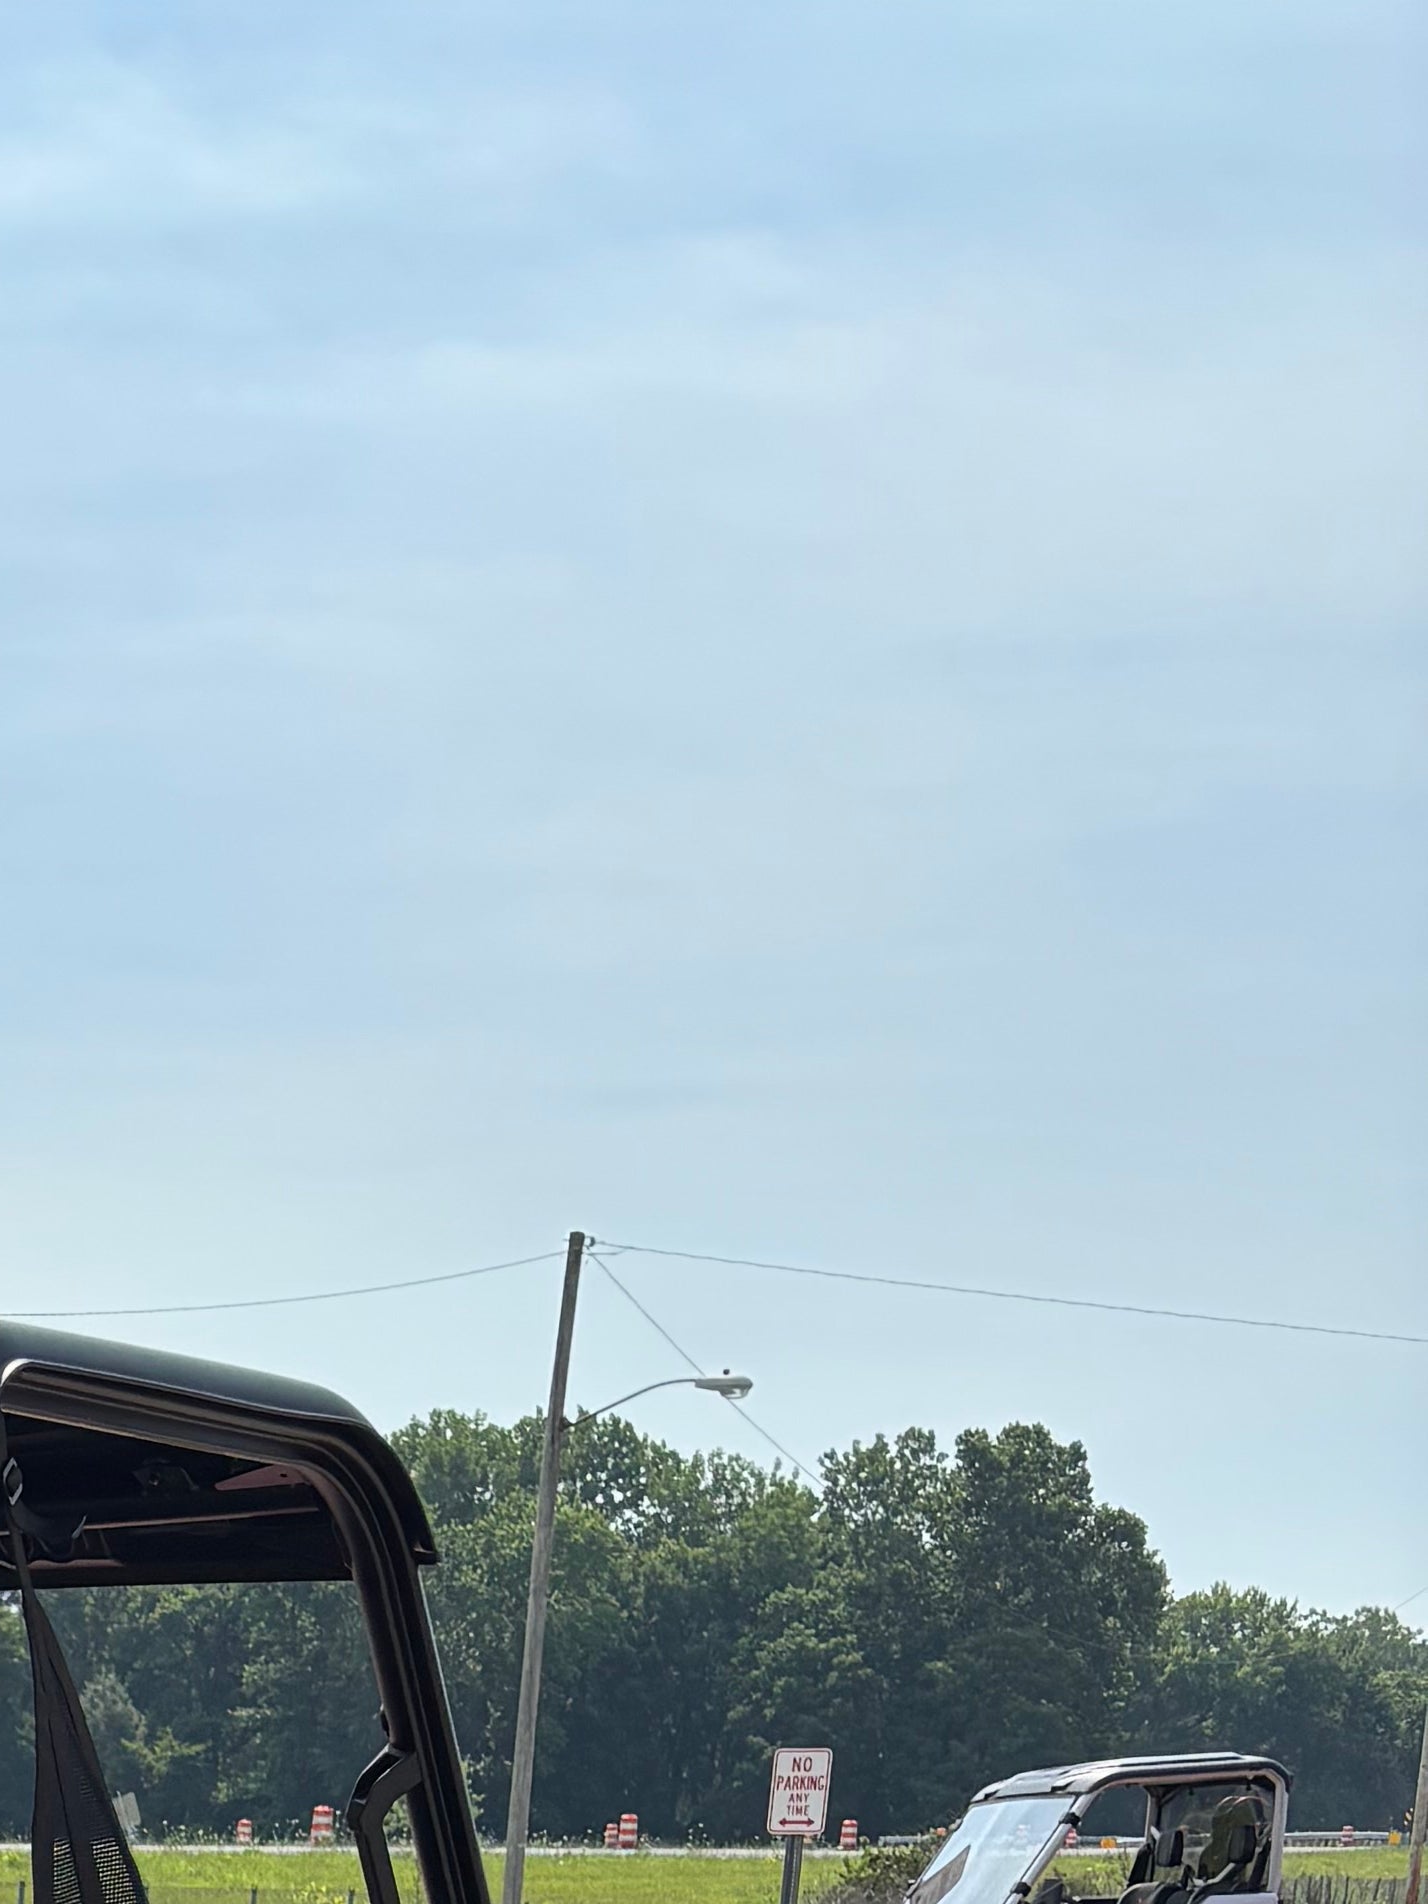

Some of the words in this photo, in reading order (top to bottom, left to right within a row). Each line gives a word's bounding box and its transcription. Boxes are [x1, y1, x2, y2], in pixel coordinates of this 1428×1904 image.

[792, 1757, 813, 1772] NO
[776, 1775, 825, 1791] PARKING
[788, 1793, 810, 1803] ANY
[787, 1805, 810, 1816] TIME
